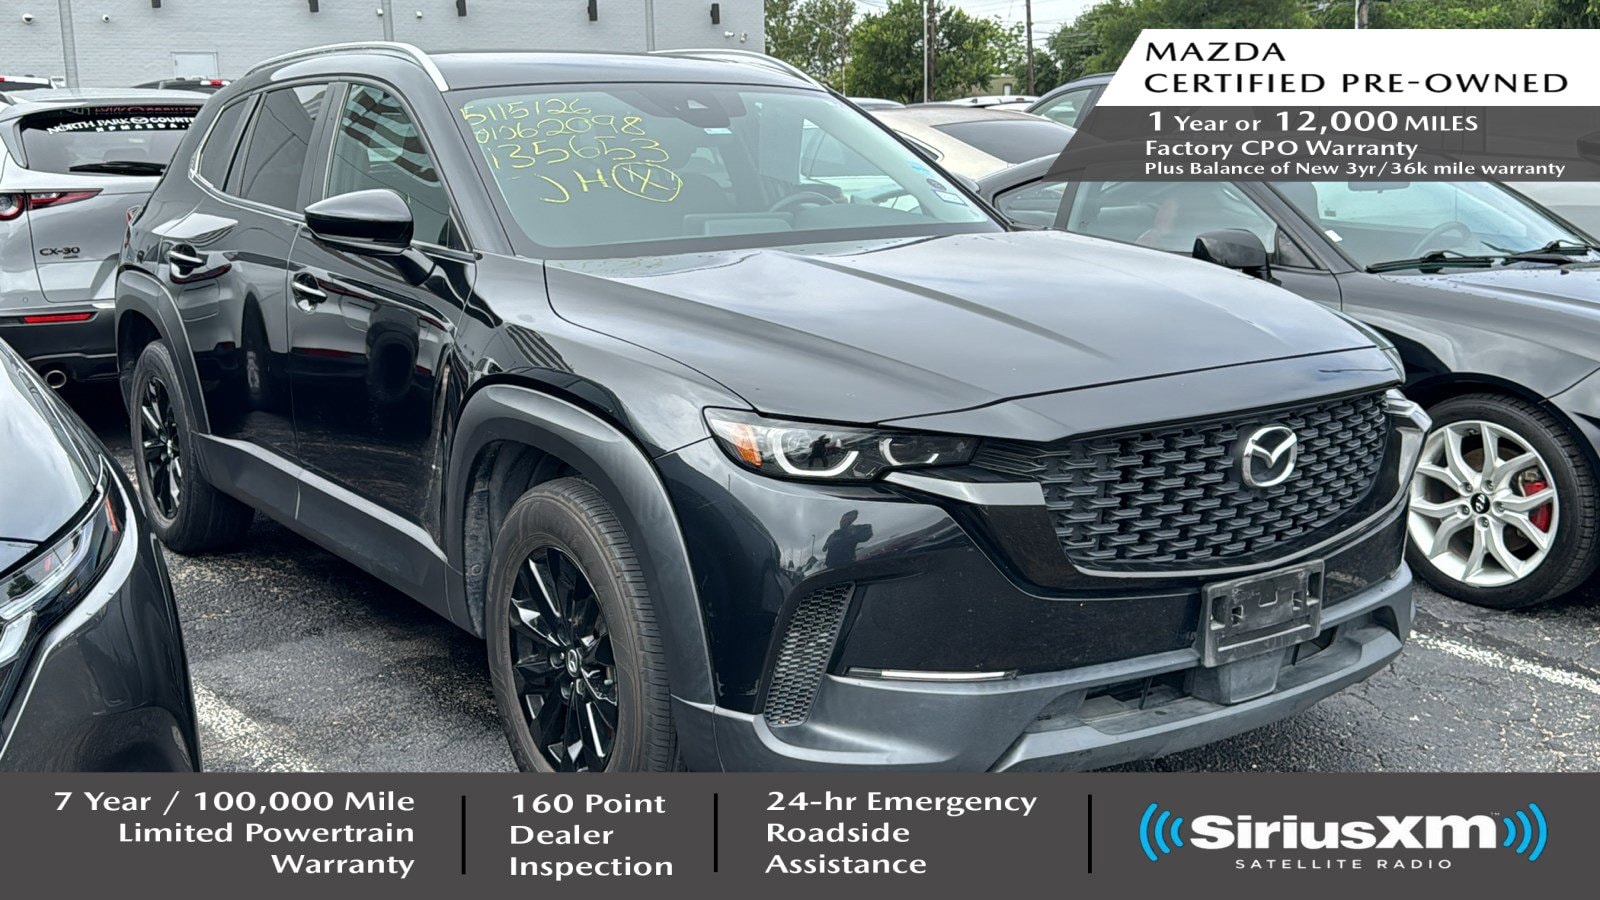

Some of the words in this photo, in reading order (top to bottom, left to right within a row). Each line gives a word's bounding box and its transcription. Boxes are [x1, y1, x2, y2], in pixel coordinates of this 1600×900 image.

[97, 118, 131, 127] PARK
[486, 137, 670, 169] 135653
[39, 247, 81, 256] CX-30
